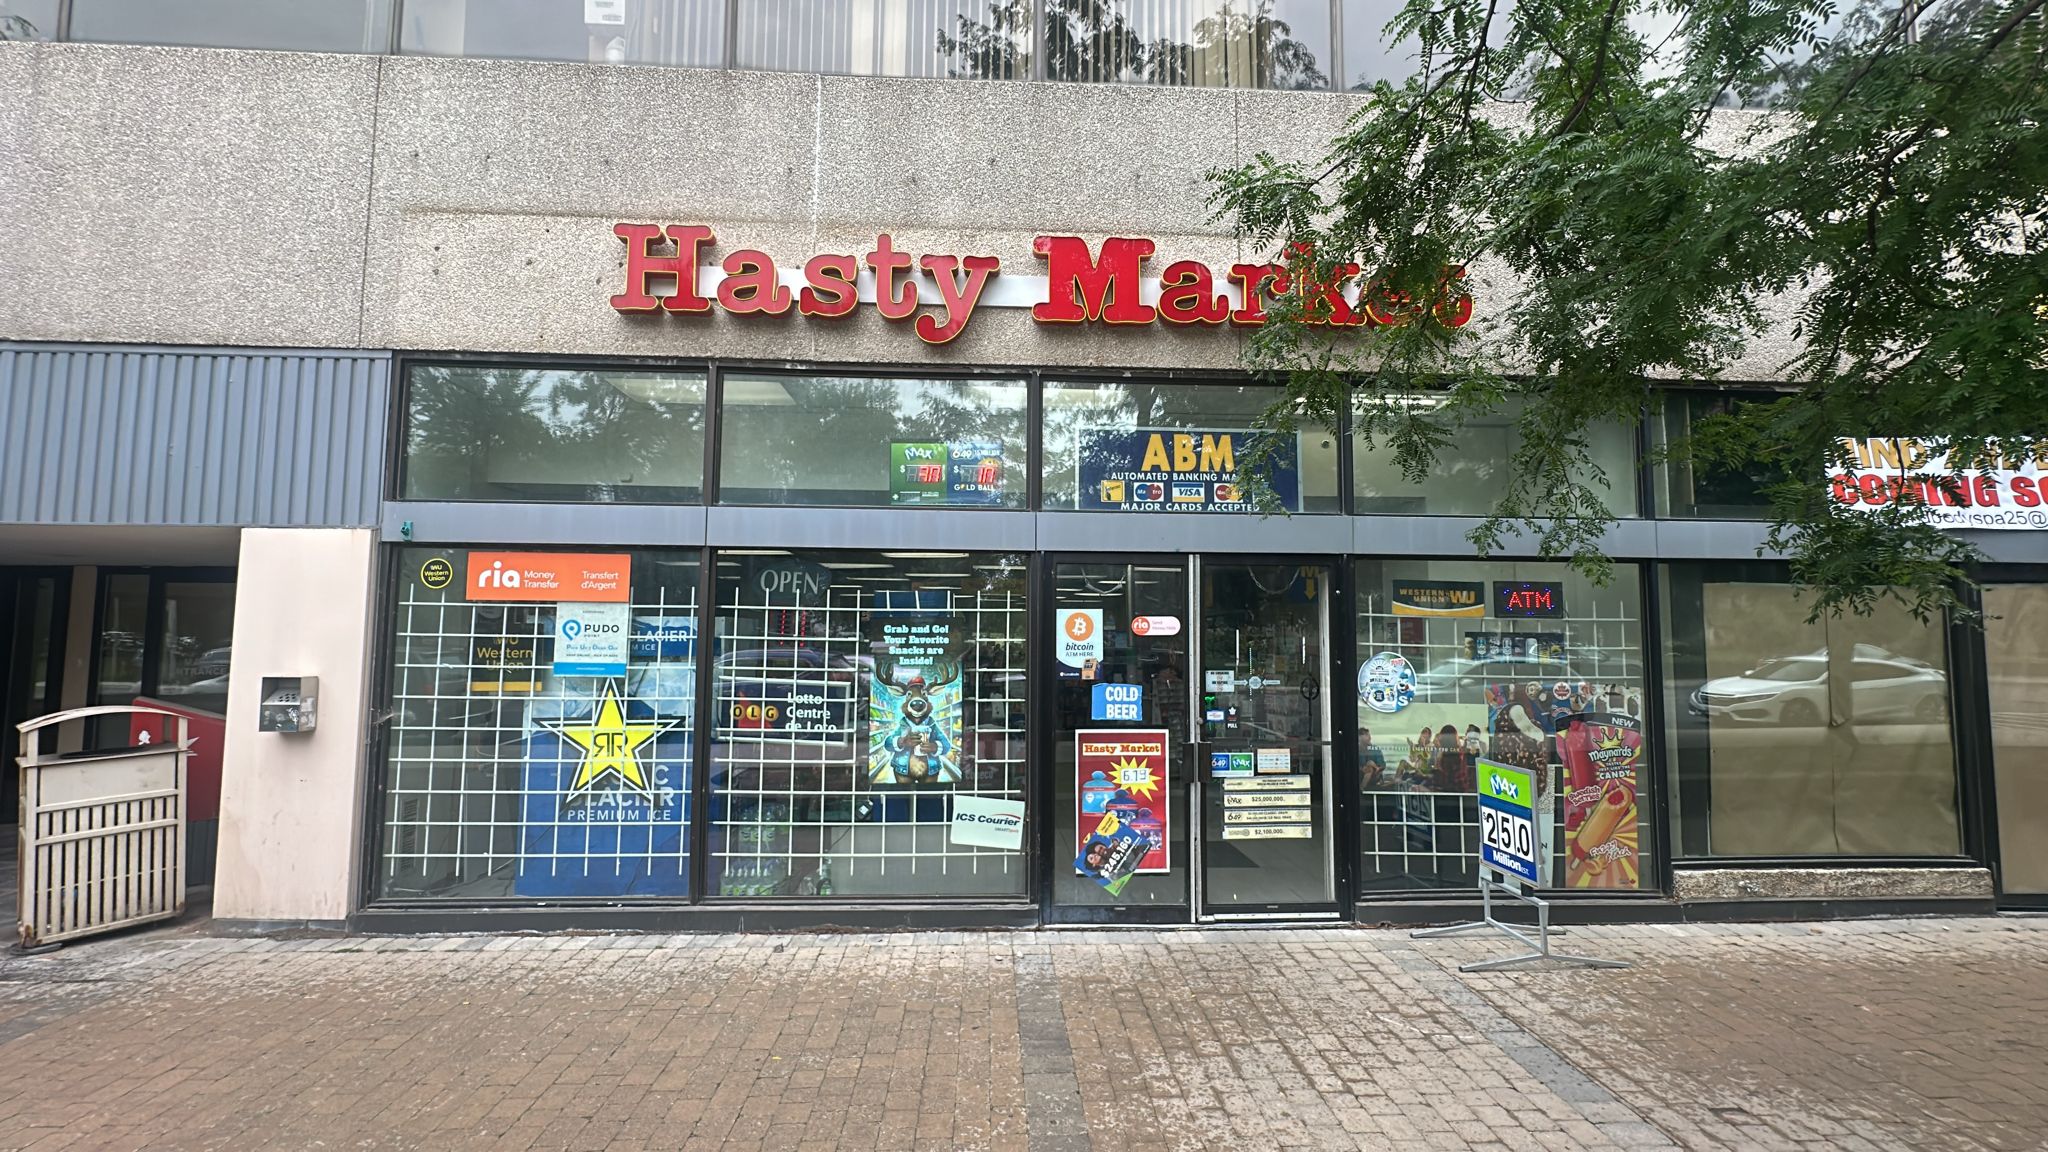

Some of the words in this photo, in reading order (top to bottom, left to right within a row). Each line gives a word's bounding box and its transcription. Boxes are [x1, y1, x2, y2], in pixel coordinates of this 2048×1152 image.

[610, 222, 1000, 345] Hasty
[1141, 433, 1235, 472] ABM
[1111, 472, 1169, 481] AUTOMATED
[1173, 473, 1218, 481] BANKING
[1178, 488, 1201, 497] VISA
[1121, 503, 1160, 511] MAJOR
[1166, 503, 1202, 511] CARDS
[1207, 503, 1260, 512] ACCEPTED
[478, 560, 521, 588] ria
[524, 570, 555, 580] Money
[582, 570, 619, 579] Transfert
[524, 580, 559, 589] Transfer
[581, 580, 617, 590] d'Argent
[760, 569, 819, 594] OPEN
[1399, 588, 1445, 597] WESTERN
[1508, 591, 1552, 609] ATM
[584, 624, 620, 633] PUDO
[883, 625, 909, 633] Grab
[911, 625, 930, 633] and
[932, 625, 949, 633] Go!
[1133, 618, 1149, 629] ria
[632, 630, 688, 642] LACIER
[883, 635, 907, 644] Your
[908, 635, 950, 644] Favorite
[476, 647, 534, 659] Wetern
[888, 646, 925, 655] Snacks
[926, 647, 944, 655] are
[1065, 643, 1094, 651] bitcoin
[899, 657, 934, 665] Inside!
[787, 692, 823, 704] Lotto
[1105, 686, 1139, 701] COLD
[786, 706, 831, 719] Centre
[1105, 704, 1138, 719] BEER
[785, 719, 802, 732] de
[807, 721, 837, 733] Loto
[1611, 717, 1634, 728] NEW
[1084, 744, 1118, 754] Hasty
[1120, 744, 1160, 753] Market
[1588, 746, 1632, 762] Maynards
[1211, 757, 1226, 767] 649
[1599, 770, 1631, 779] CANDY
[1490, 774, 1518, 800] MAX
[1568, 785, 1601, 800] Swedish
[570, 786, 675, 807] LACIR
[567, 809, 639, 821] PREMIUM
[647, 809, 672, 821] ICE
[955, 812, 976, 822] ICS
[977, 815, 1020, 826] Courier
[1590, 839, 1617, 857] Fuzzy
[1100, 835, 1132, 878] $245,160
[1492, 849, 1522, 871] Million
